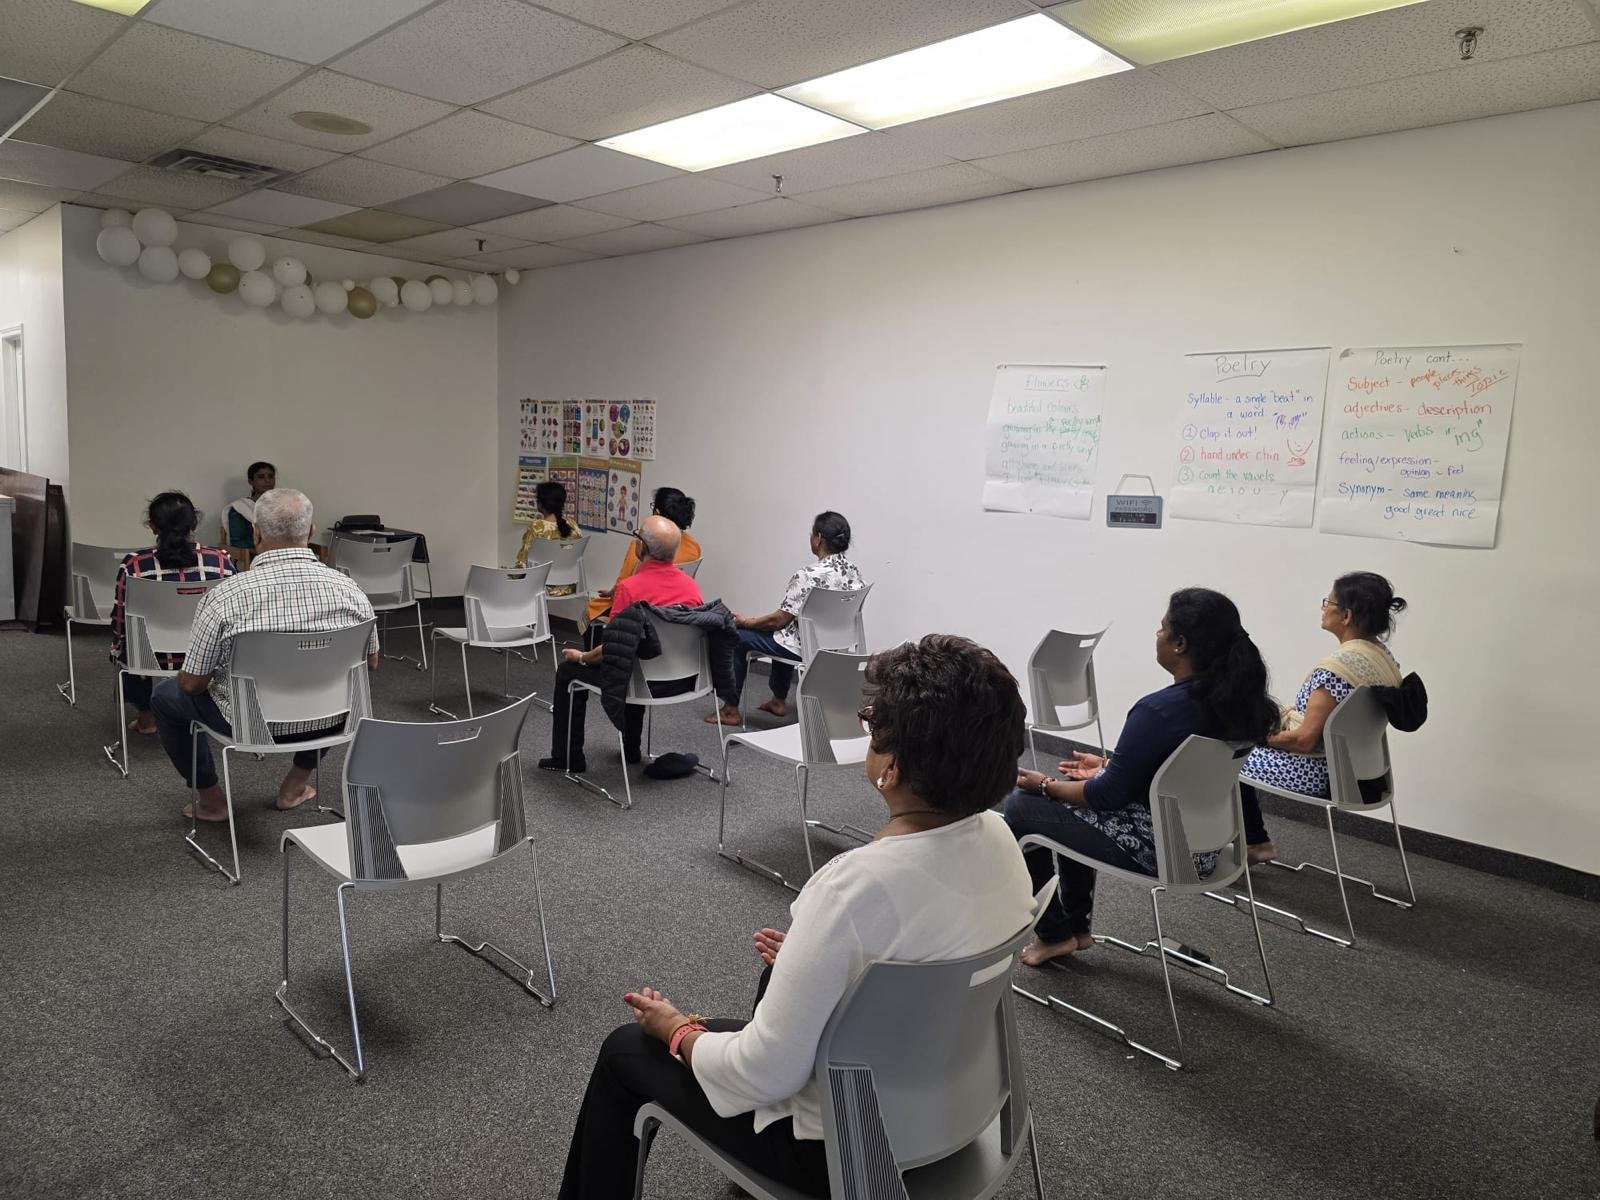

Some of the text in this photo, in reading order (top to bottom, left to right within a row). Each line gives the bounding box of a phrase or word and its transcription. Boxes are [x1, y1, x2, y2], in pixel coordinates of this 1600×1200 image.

[1215, 354, 1272, 377] Poetry
[1374, 350, 1412, 370] Poetry
[1347, 376, 1391, 395] Subject
[1187, 392, 1223, 408] Syllable
[1303, 394, 1313, 403] in
[1240, 409, 1264, 418] word
[1417, 400, 1492, 420] description
[1200, 427, 1220, 441] Clap
[1224, 427, 1232, 438] it
[1236, 426, 1257, 440] out!
[1342, 427, 1383, 441] actions
[1200, 447, 1222, 461] hand
[1226, 449, 1249, 460] under
[1226, 469, 1237, 480] the
[1384, 503, 1478, 520] good great nice
